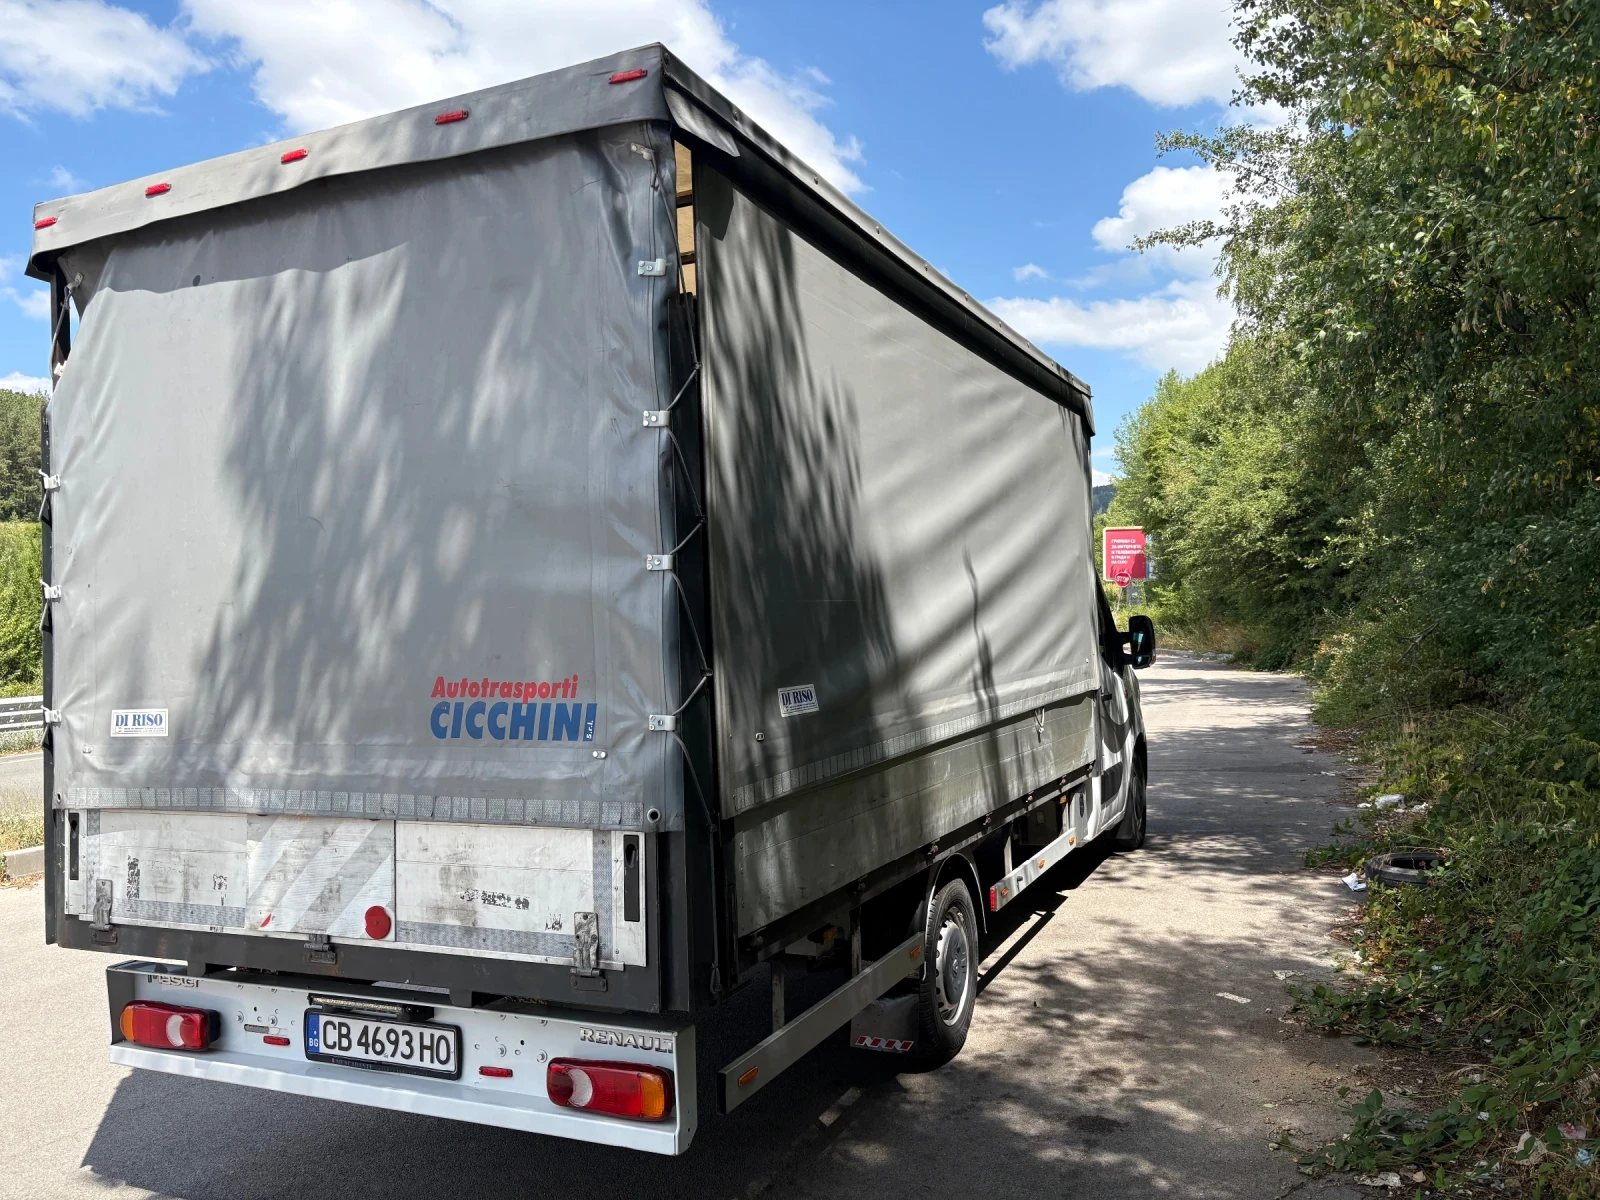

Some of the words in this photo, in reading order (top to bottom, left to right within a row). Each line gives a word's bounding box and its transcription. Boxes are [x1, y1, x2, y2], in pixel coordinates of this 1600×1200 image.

[431, 674, 579, 704] Autotrasporti
[781, 692, 792, 706] DI
[792, 689, 813, 704] RISO
[115, 714, 129, 727] DI
[132, 713, 163, 727] RISO
[430, 701, 598, 742] CICCHINI
[308, 1037, 319, 1048] BG
[323, 1020, 352, 1051] CB
[357, 1025, 414, 1060] 4693
[580, 1027, 673, 1053] RENAULT
